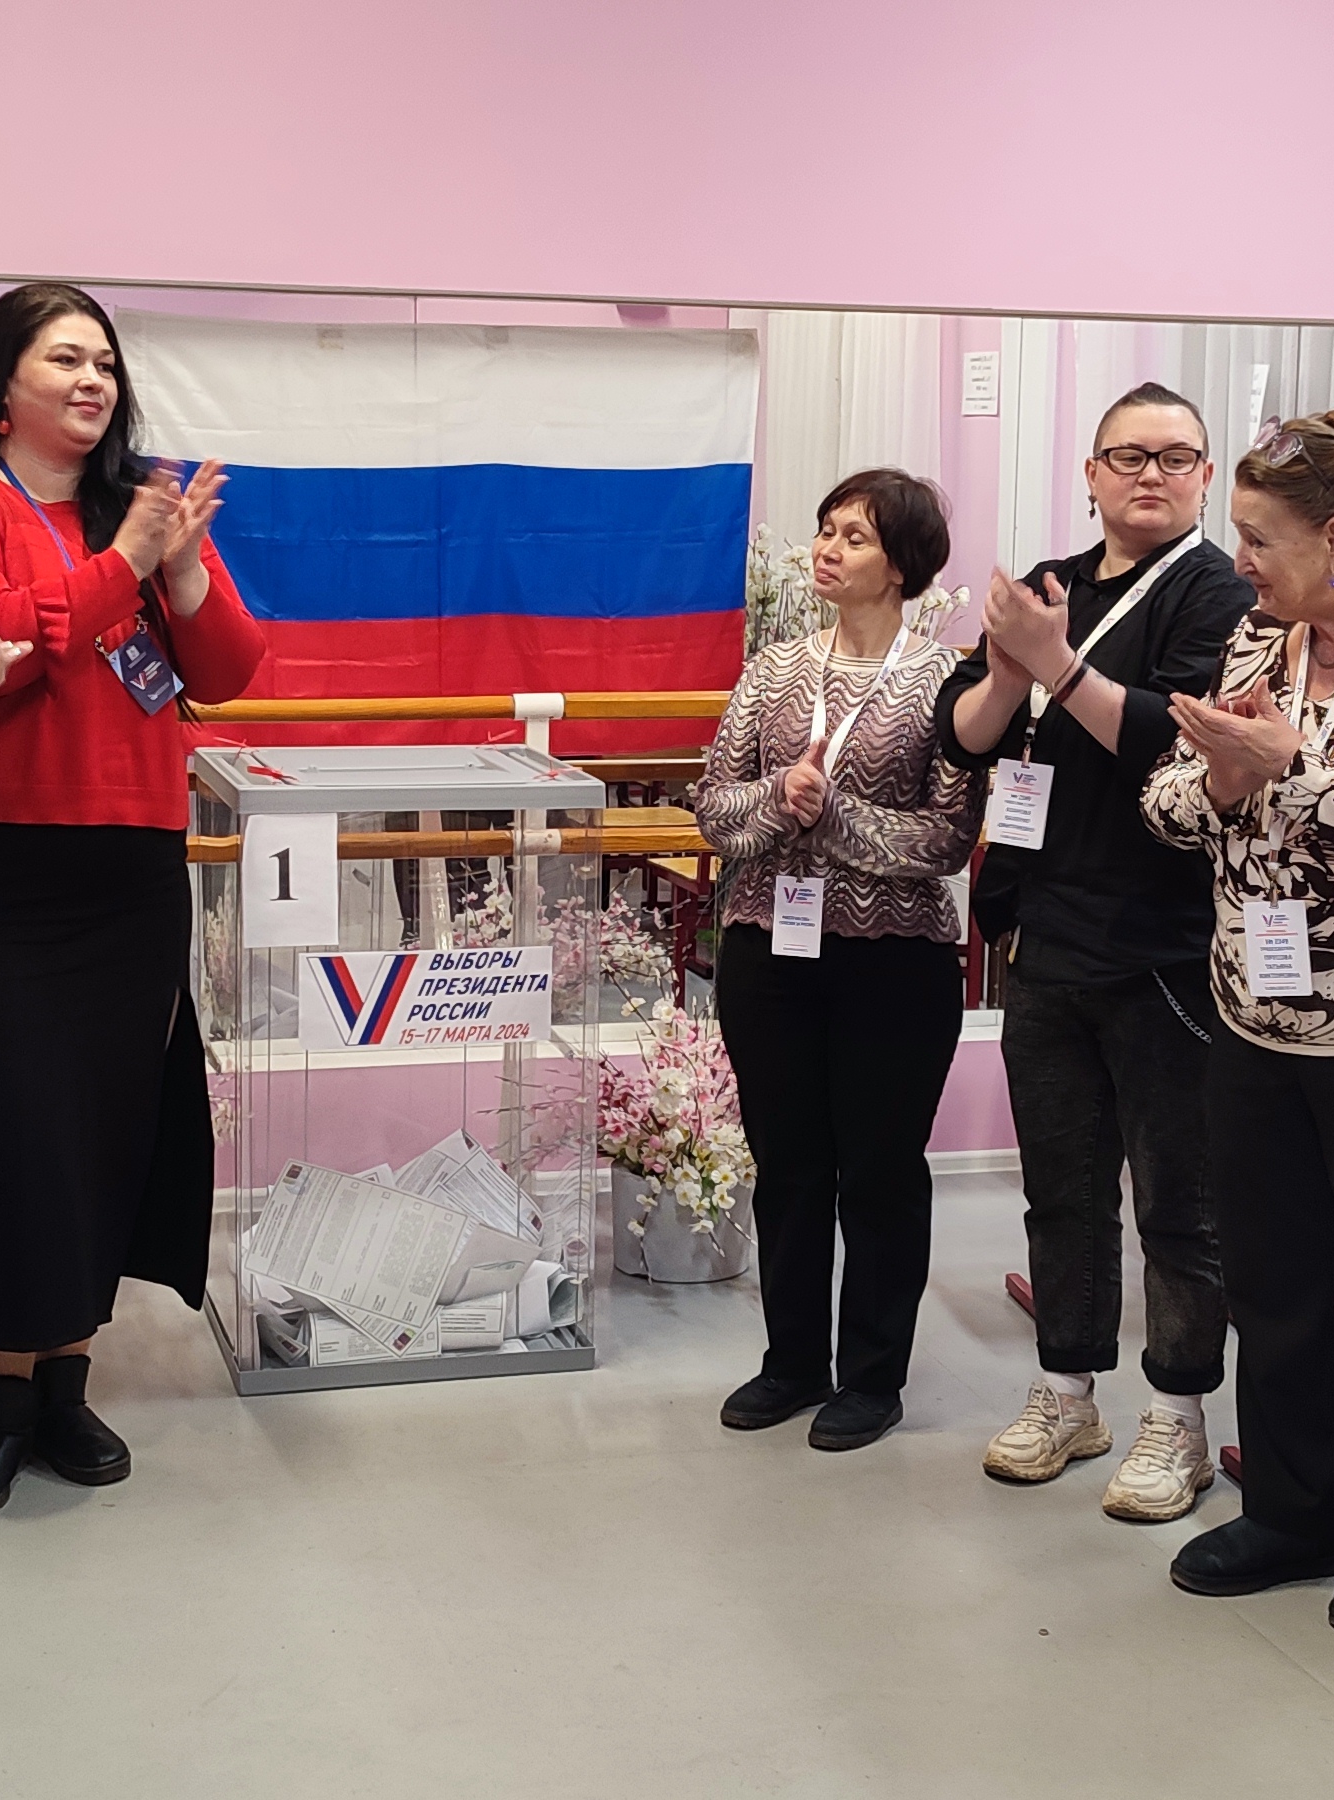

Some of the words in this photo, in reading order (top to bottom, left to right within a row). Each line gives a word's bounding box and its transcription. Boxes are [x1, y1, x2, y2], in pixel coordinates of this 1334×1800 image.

[268, 847, 299, 902] 1
[428, 950, 523, 971] ВЫБОРЫ
[417, 973, 549, 997] ПРЕЗИДЕНТА
[406, 1001, 493, 1023] РОССИИ
[441, 1025, 493, 1043] МАРТА
[494, 1022, 530, 1041] 2024
